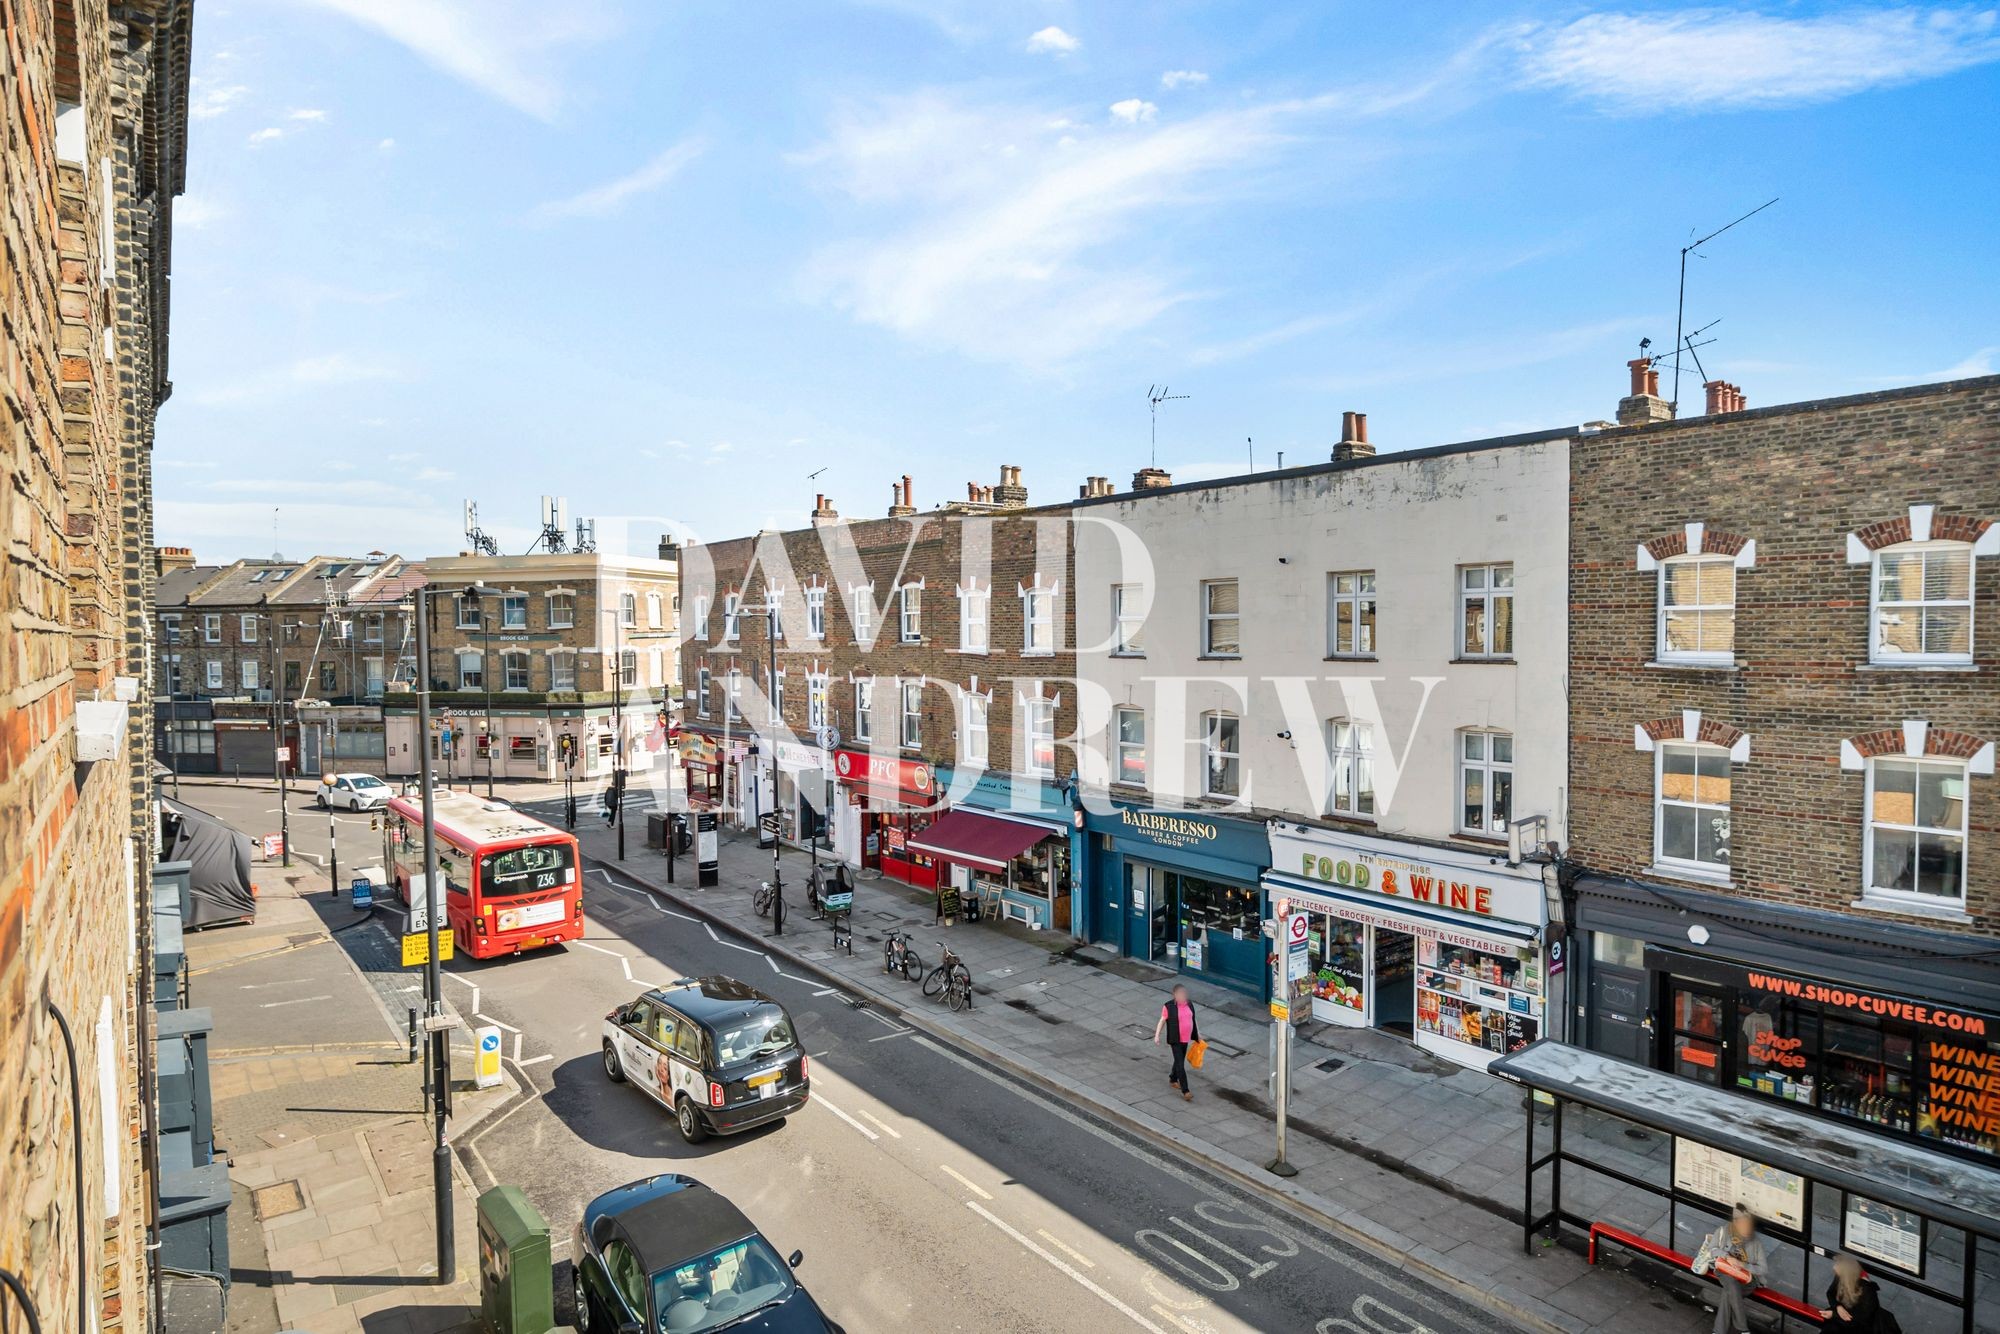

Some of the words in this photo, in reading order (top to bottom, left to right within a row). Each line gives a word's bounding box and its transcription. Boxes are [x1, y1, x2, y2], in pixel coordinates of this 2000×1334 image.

[446, 709, 468, 717] ROOK
[469, 709, 486, 717] GATE
[870, 760, 896, 778] PFC
[1122, 810, 1217, 840] BARBERESSO
[1137, 828, 1163, 838] BARBER
[1172, 834, 1199, 845] COFFEE
[537, 872, 555, 888] 236
[1302, 852, 1370, 888] FOOD
[1381, 869, 1399, 894] &
[1409, 873, 1492, 914] WINE
[415, 916, 443, 928] ENS
[1287, 897, 1301, 907] OFF
[1302, 900, 1333, 914] LICENCE
[1339, 909, 1376, 924] GROCERY
[1383, 919, 1409, 932] FRESH
[1411, 925, 1438, 938] FRUIT
[1439, 931, 1446, 940] &
[1447, 934, 1507, 955] VEGETABLES
[1748, 973, 1985, 1035] WWW.SHOPCUVEE.COM
[1756, 1030, 1802, 1051] shop
[1930, 1041, 2000, 1072] WINE
[1930, 1062, 2000, 1094] WINE
[1930, 1082, 2000, 1115] WINE
[1930, 1102, 2000, 1136] WINE
